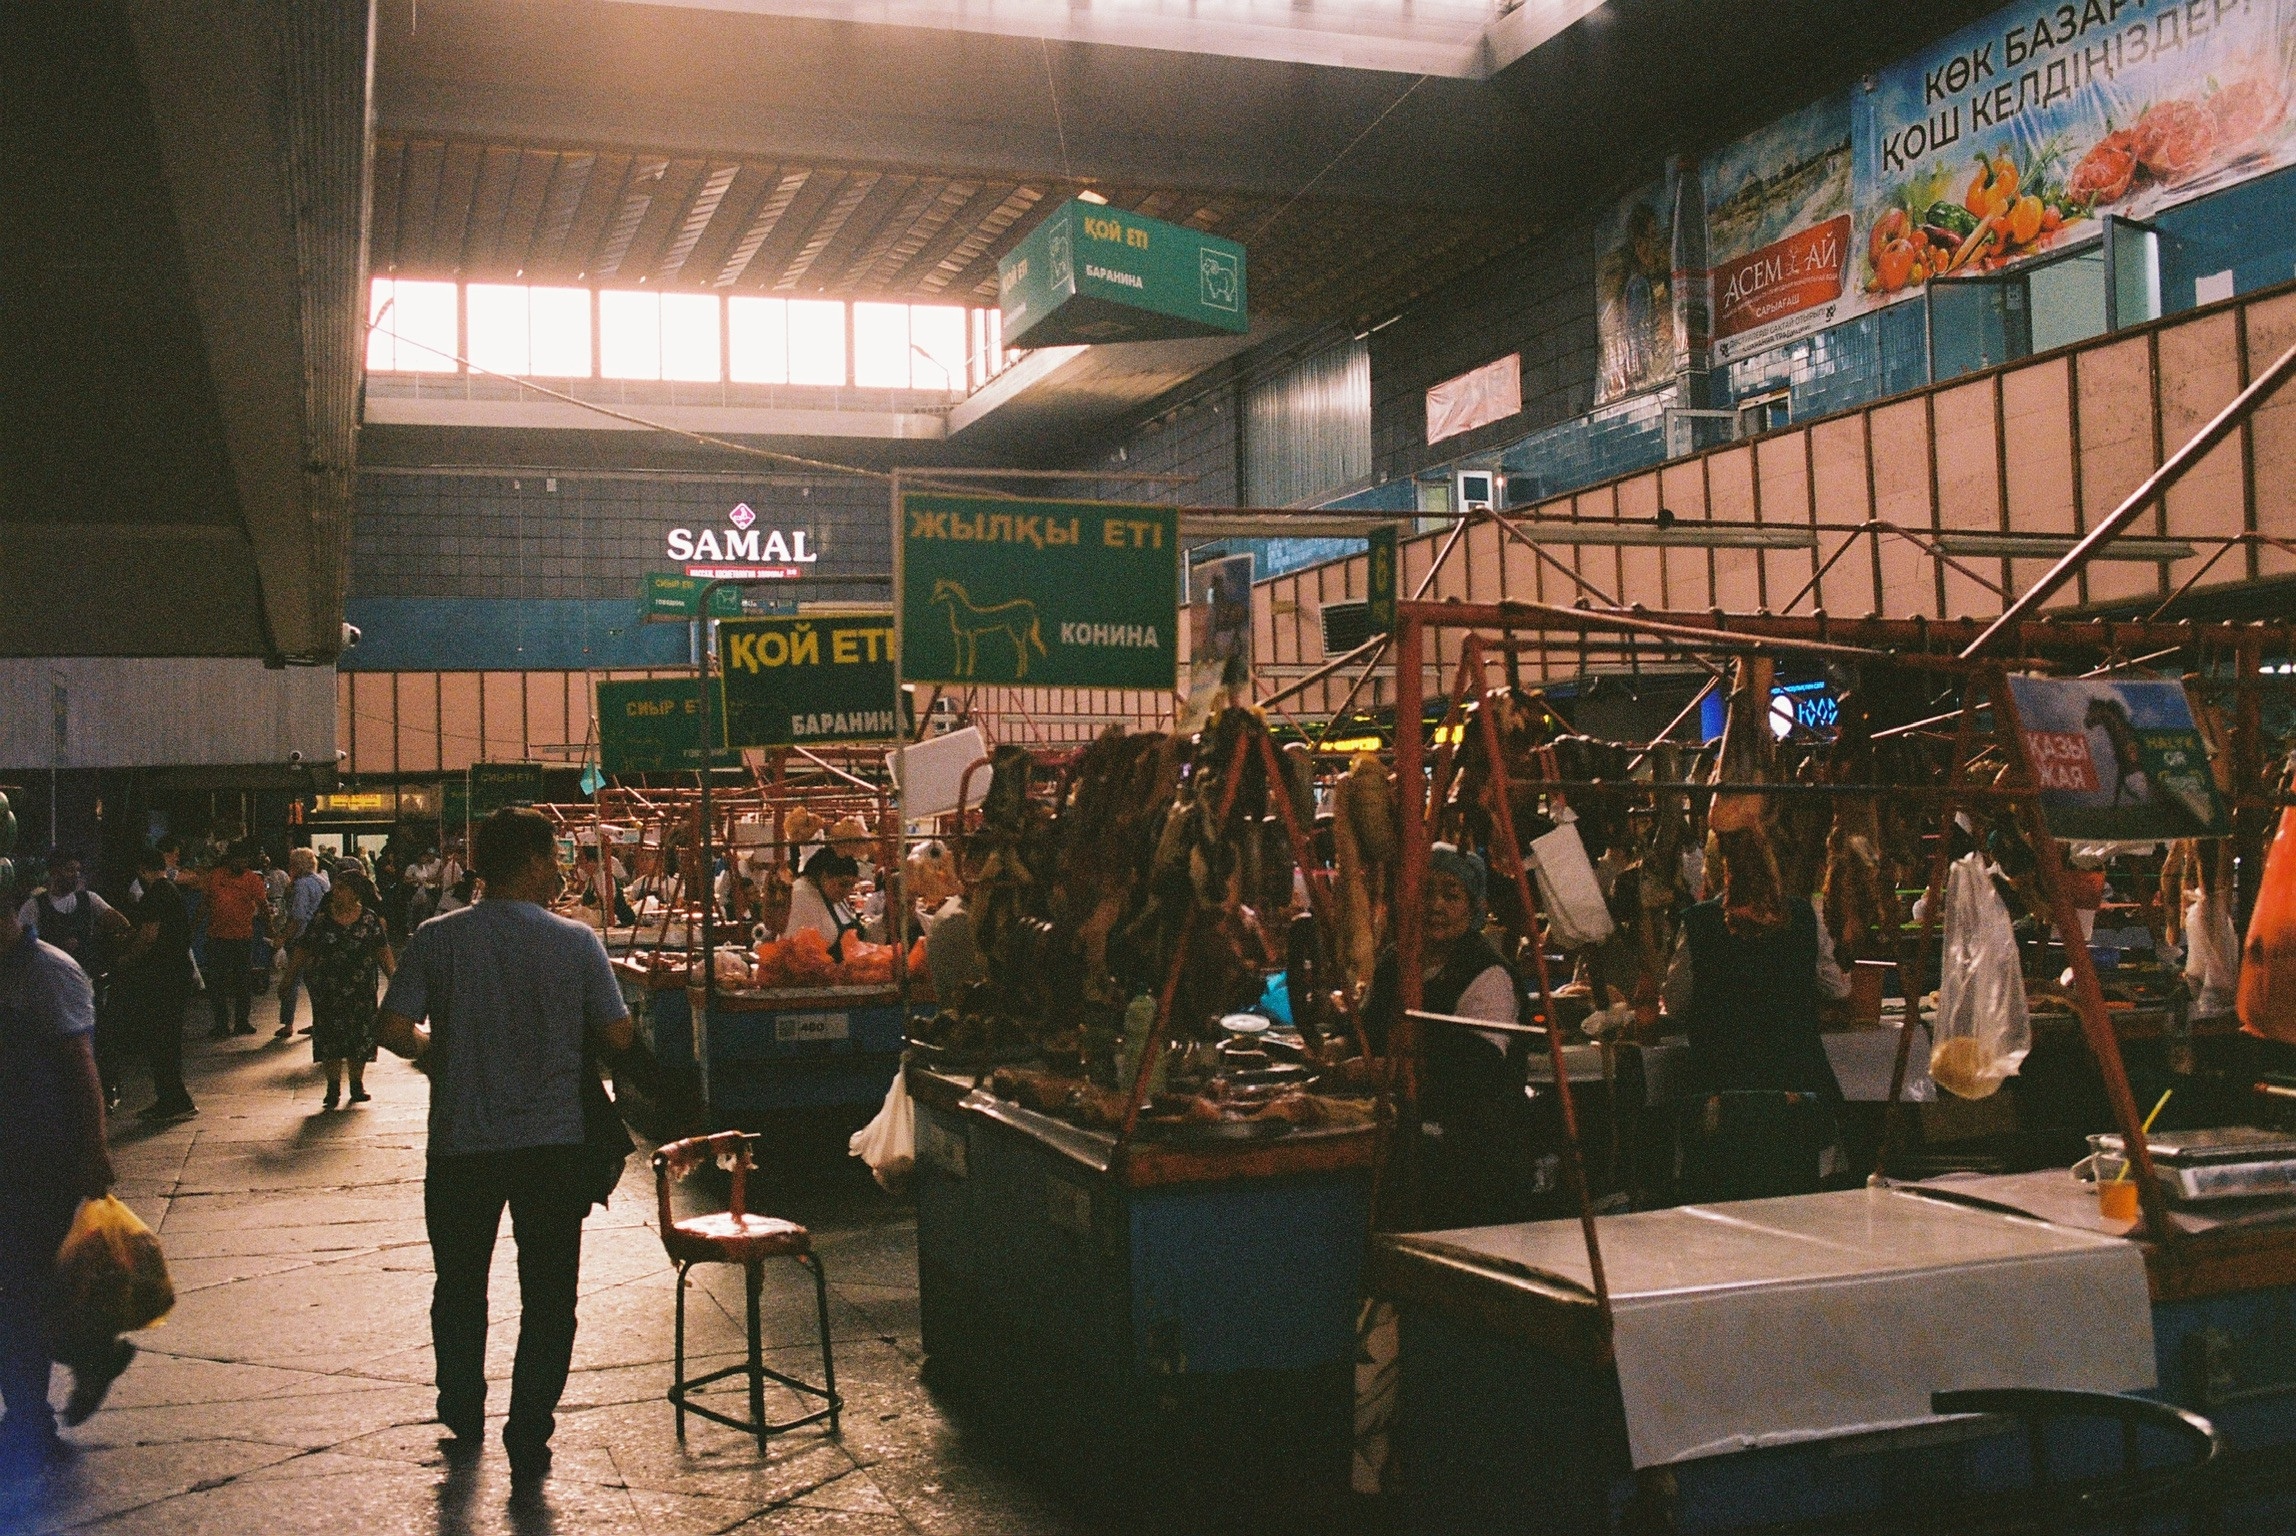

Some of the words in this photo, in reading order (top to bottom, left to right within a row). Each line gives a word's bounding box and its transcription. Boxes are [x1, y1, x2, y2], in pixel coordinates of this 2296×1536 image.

[1924, 42, 1994, 106] КӨК
[2005, 0, 2144, 69] БАЗА
[1882, 106, 1960, 172] ҚОШ
[1086, 264, 1143, 289] БАРАНИНА
[1723, 254, 1783, 309] АСЕМ
[667, 528, 817, 562] SAMAL
[910, 511, 1080, 549] ЖЫЛҚЫ
[1103, 518, 1163, 548] ЕТІ
[731, 623, 819, 674] ҚОЙ
[1061, 622, 1160, 649] КОНИНА
[626, 701, 674, 716] СИЫР
